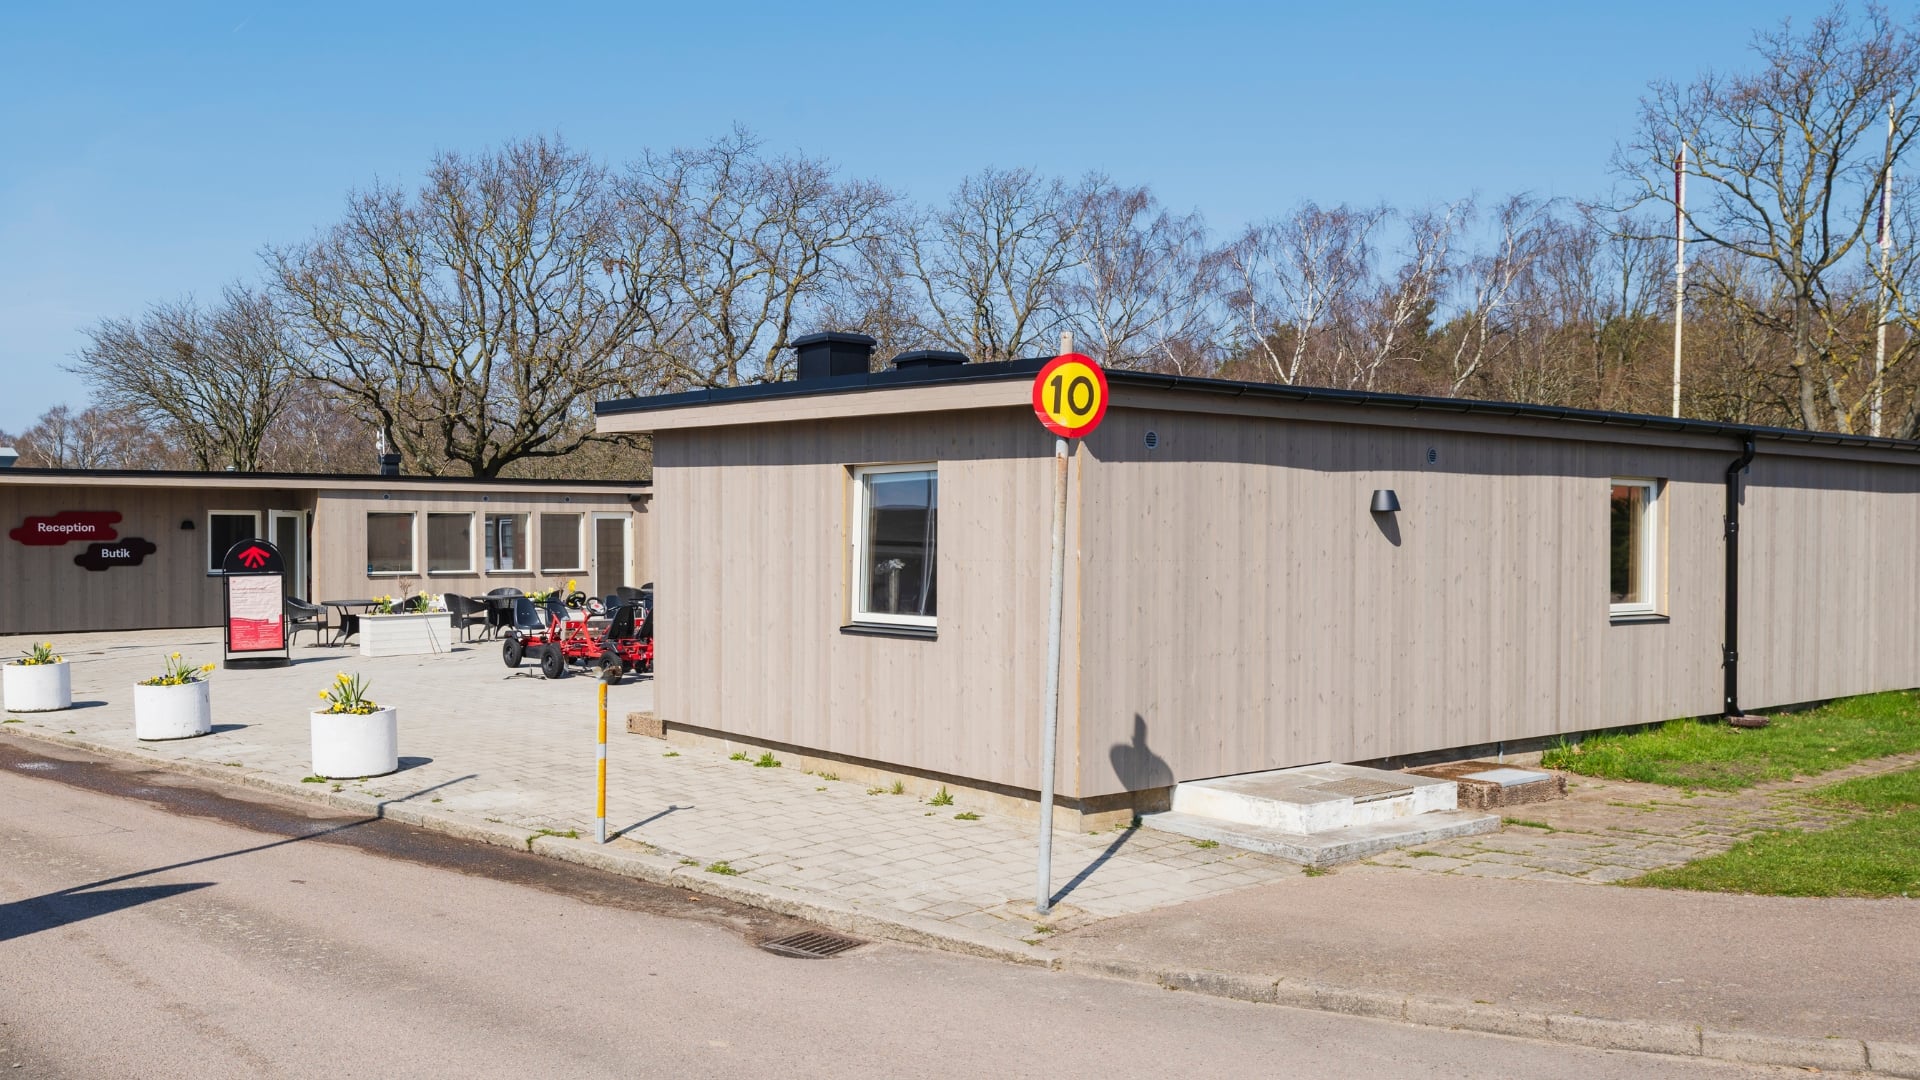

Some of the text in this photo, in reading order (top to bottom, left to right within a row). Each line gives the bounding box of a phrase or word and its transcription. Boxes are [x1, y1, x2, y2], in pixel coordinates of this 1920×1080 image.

[1050, 375, 1095, 416] 10
[38, 522, 95, 534] Reception
[101, 548, 130, 558] Butik
